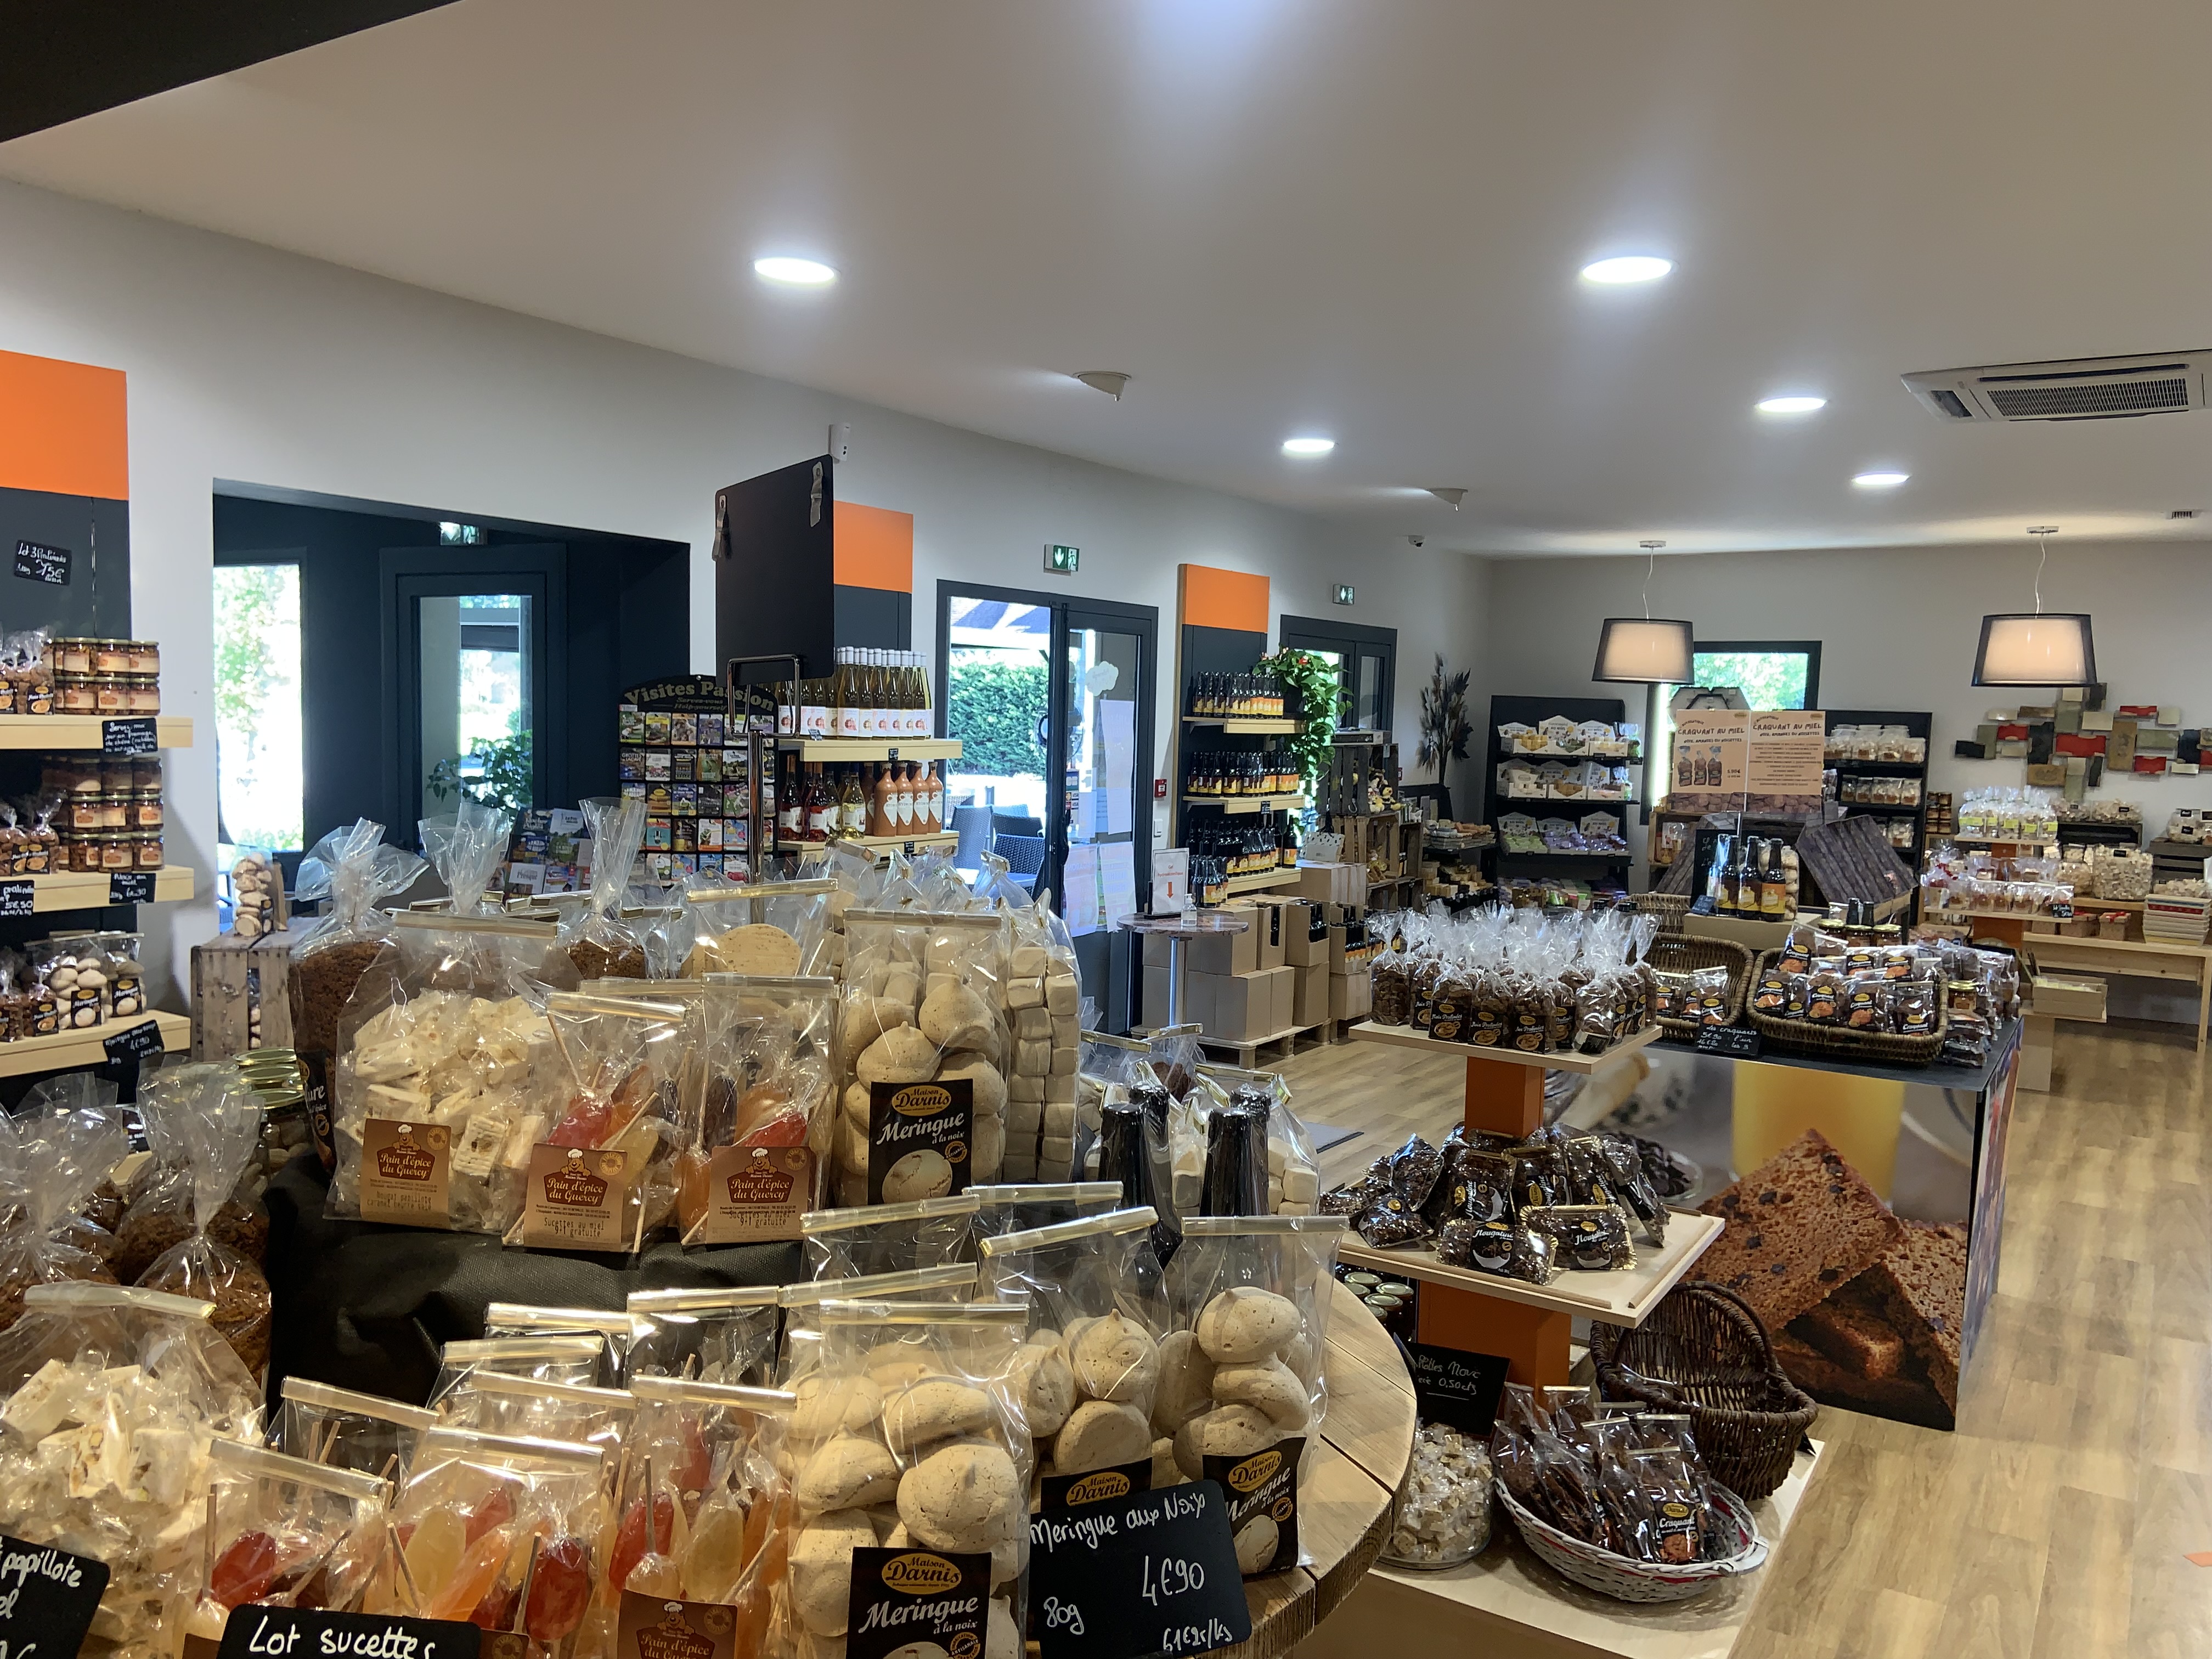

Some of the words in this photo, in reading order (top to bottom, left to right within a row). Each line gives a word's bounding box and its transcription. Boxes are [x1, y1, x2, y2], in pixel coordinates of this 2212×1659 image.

[625, 684, 695, 704] Visites
[895, 1092, 951, 1108] Darnis
[876, 1113, 964, 1145] Meringue
[932, 1136, 937, 1144] à
[939, 1133, 946, 1143] la
[947, 1131, 965, 1141] noix
[380, 1153, 400, 1165] Pain
[403, 1155, 432, 1169] d'épice
[382, 1164, 394, 1173] du
[396, 1164, 430, 1180] Quercy
[547, 1178, 569, 1190] Pain
[571, 1181, 603, 1194] d'épice
[731, 1179, 754, 1189] Pain
[757, 1178, 790, 1192] d'épice
[549, 1189, 562, 1199] du
[565, 1190, 599, 1205] Quercy
[733, 1189, 747, 1199] du
[750, 1188, 785, 1202] Quercy
[544, 1217, 574, 1228] Sucettes
[589, 1220, 605, 1231] miel
[755, 1217, 787, 1228] gratuite
[569, 1228, 601, 1238] gratuite
[1472, 1229, 1514, 1238] Nougatine
[1232, 1455, 1282, 1485] Darnis
[1248, 1454, 1273, 1471] Maison
[1088, 1476, 1118, 1486] Maison
[1069, 1480, 1128, 1503] Darnis
[1225, 1467, 1290, 1522] Meringue
[1267, 1494, 1274, 1505] la
[1274, 1486, 1290, 1500] noix
[1659, 1517, 1695, 1527] Craquant
[1030, 1517, 1118, 1553] Meringue
[1, 1550, 82, 1588] papillote
[907, 1556, 945, 1568] Maison
[885, 1560, 960, 1583] Darnis
[1142, 1555, 1205, 1606] 4€90
[858, 1597, 979, 1633] Meringue
[1043, 1596, 1085, 1635] 80g
[933, 1623, 940, 1634] à
[943, 1621, 953, 1633] la
[955, 1619, 978, 1630] noix
[249, 1615, 301, 1655] Lot
[641, 1633, 668, 1649] Pain
[671, 1639, 710, 1656] d'épice
